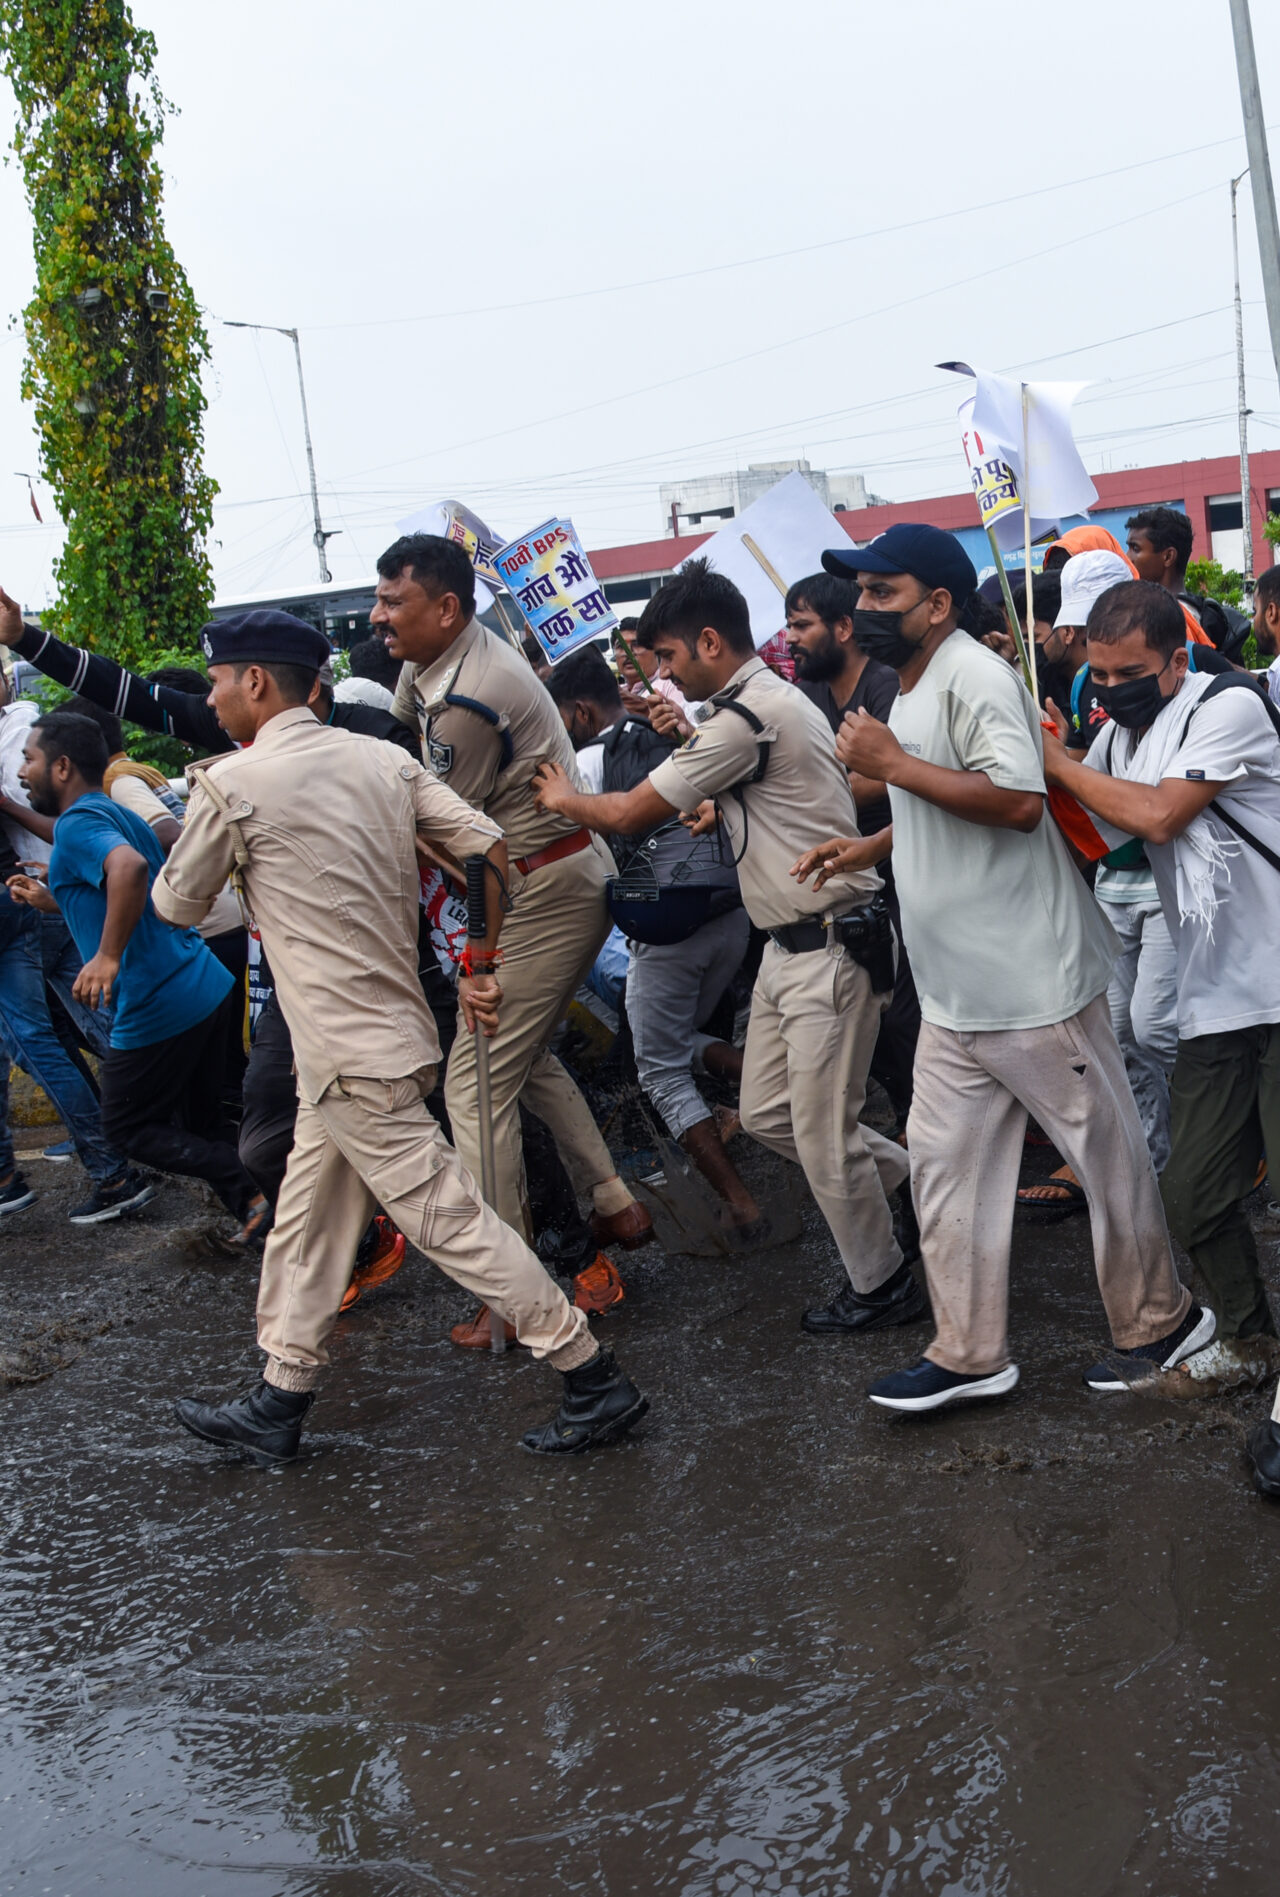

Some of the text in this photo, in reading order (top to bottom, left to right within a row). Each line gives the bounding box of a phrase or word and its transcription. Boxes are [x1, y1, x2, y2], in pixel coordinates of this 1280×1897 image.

[501, 525, 577, 577] 70वीं BPS
[516, 573, 558, 613] जांच
[537, 607, 575, 646] एक
